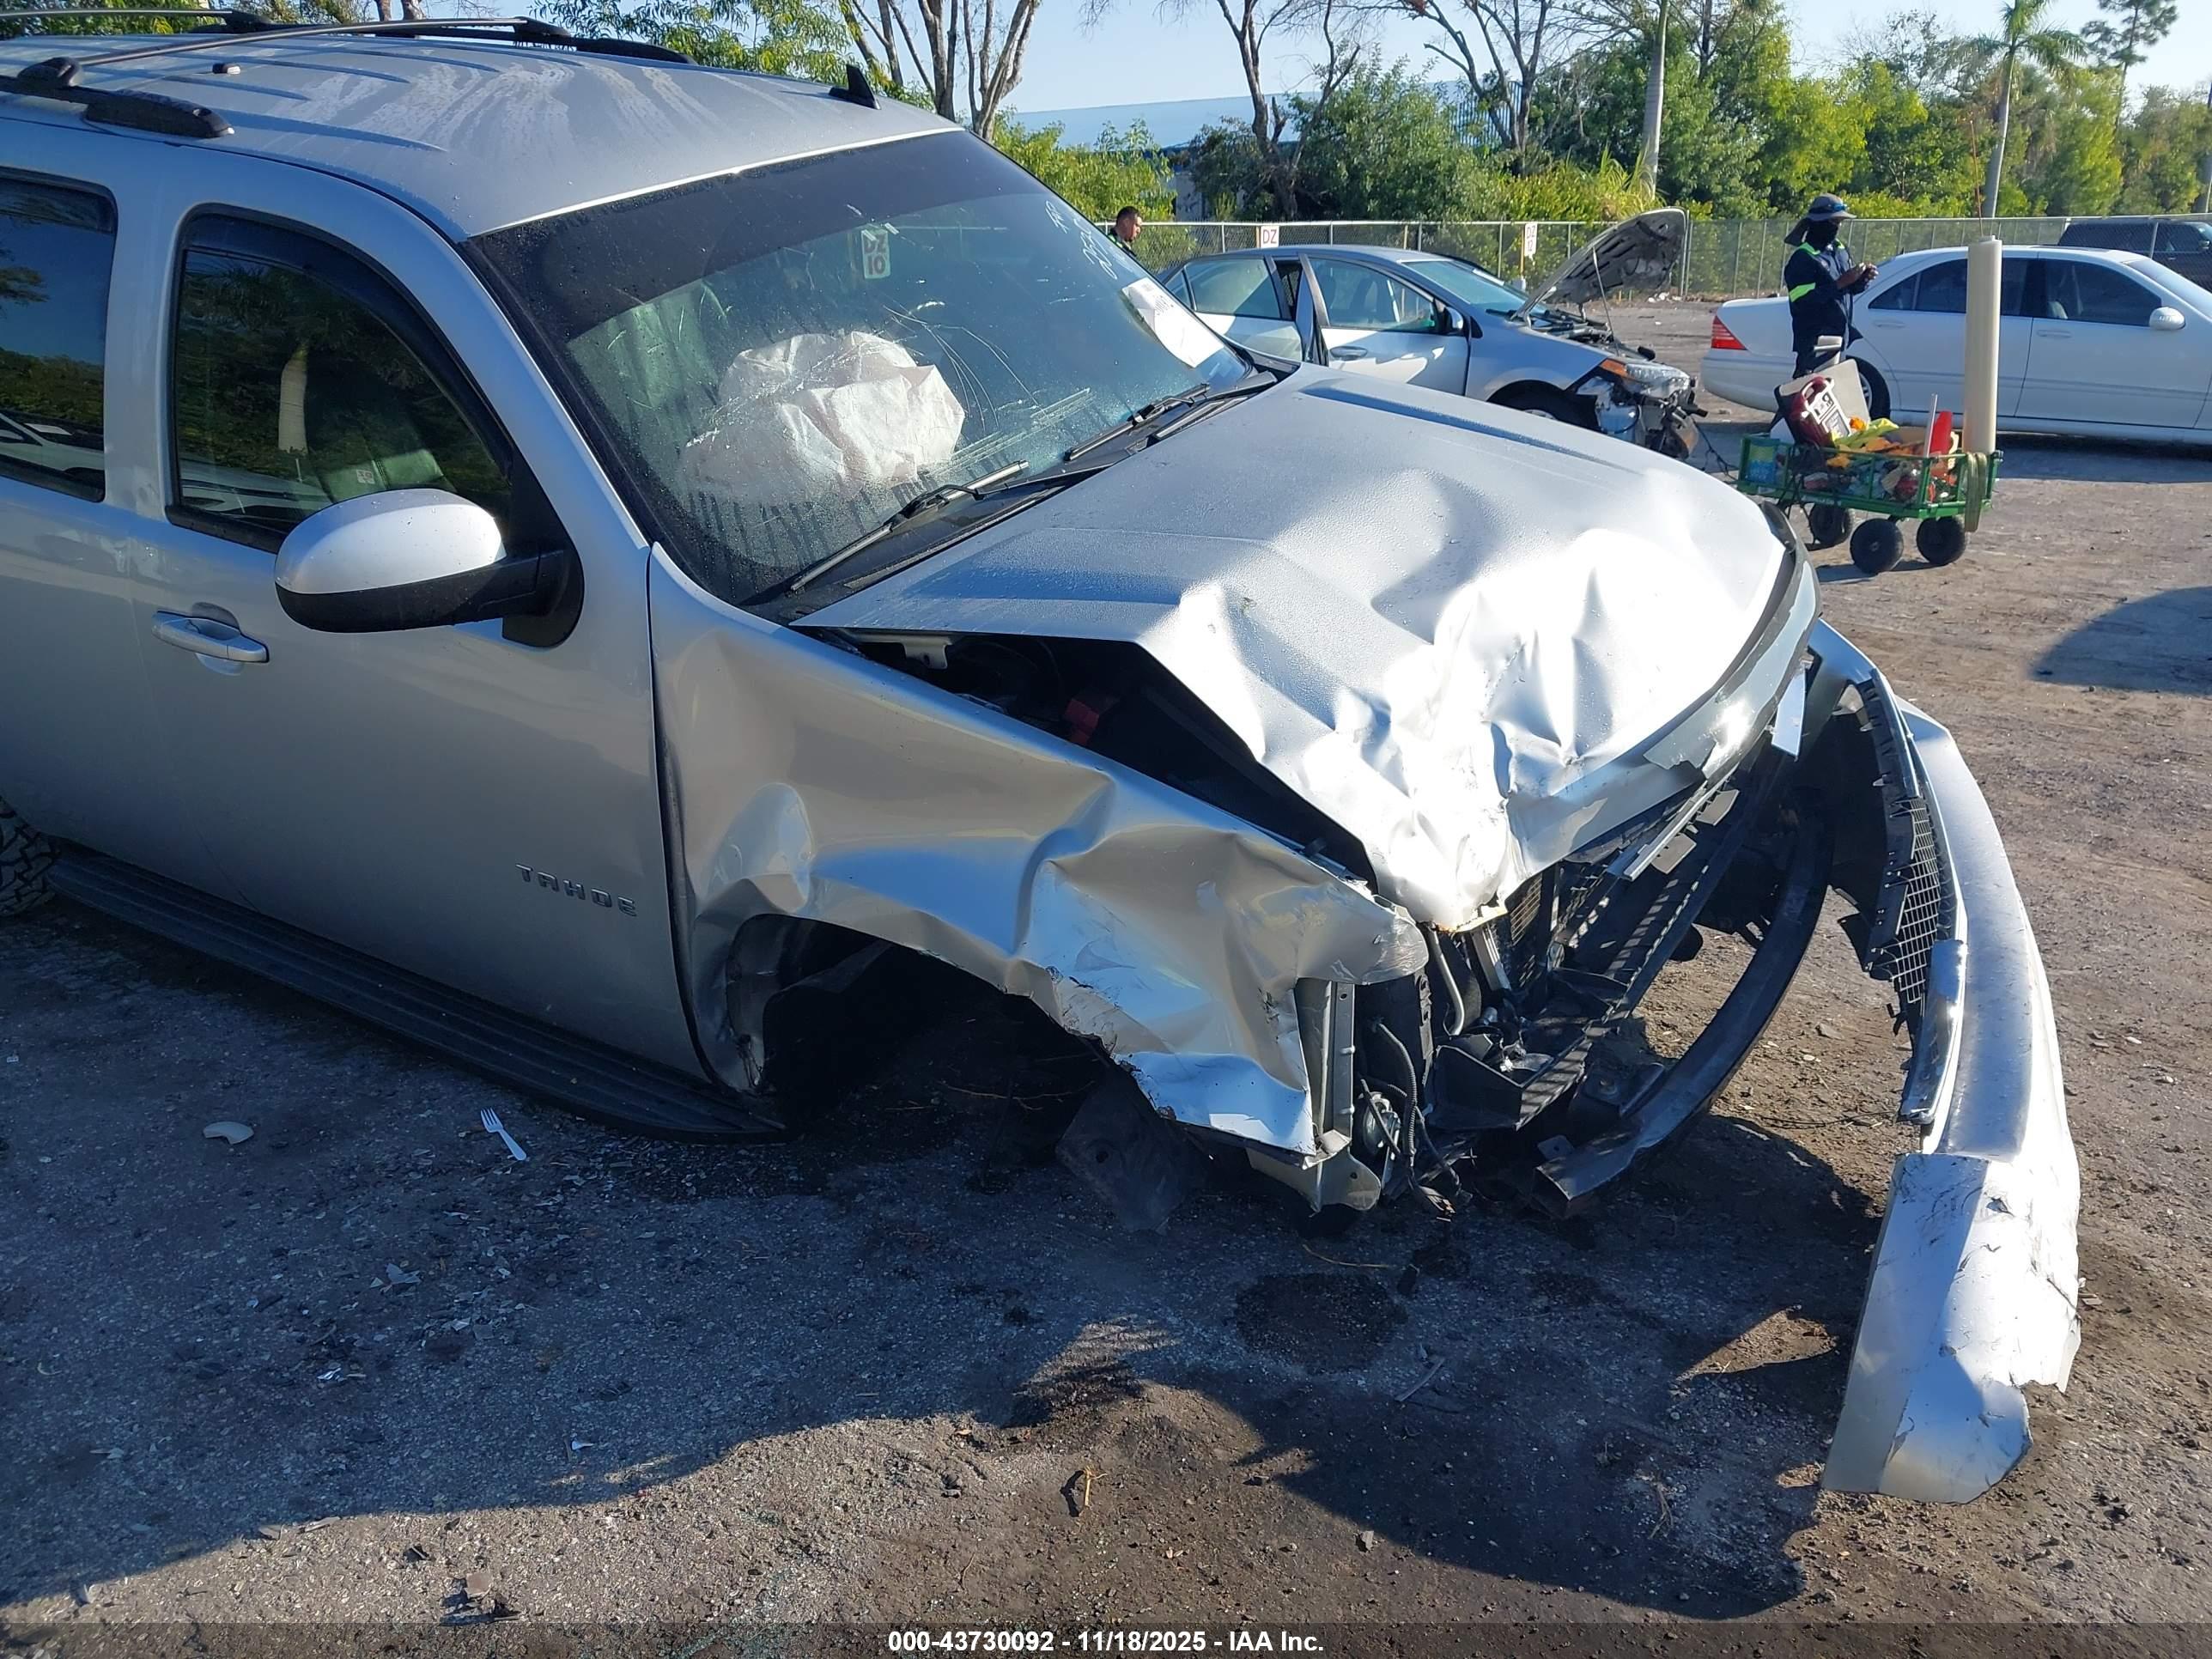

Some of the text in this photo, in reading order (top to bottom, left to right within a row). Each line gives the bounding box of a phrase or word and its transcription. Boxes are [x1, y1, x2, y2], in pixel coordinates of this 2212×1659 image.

[1262, 228, 1277, 245] DZ
[1527, 225, 1535, 239] DZ
[866, 254, 887, 275] 10
[515, 863, 637, 917] TAHOE
